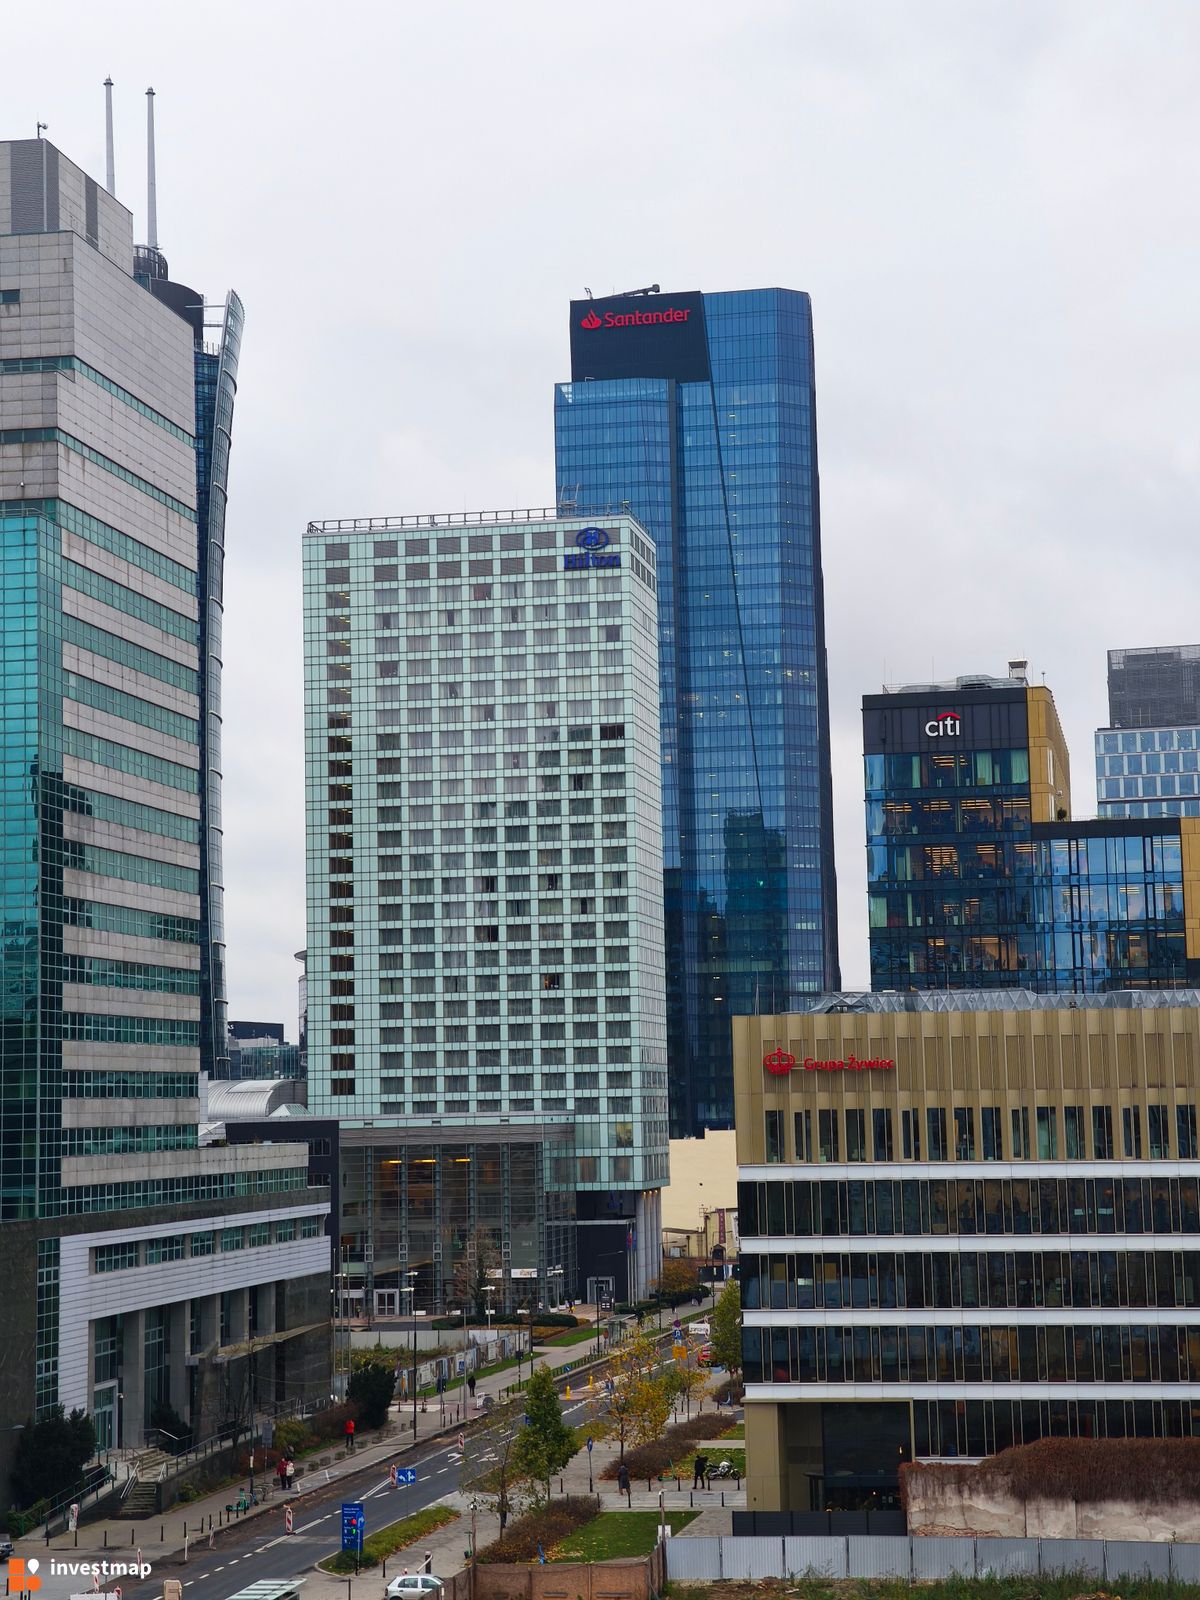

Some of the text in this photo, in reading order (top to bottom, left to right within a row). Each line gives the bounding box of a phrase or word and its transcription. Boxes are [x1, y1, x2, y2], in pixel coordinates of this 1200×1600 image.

[604, 308, 690, 328] Santander
[564, 551, 621, 570] Hilton
[925, 714, 960, 737] citi
[804, 1057, 844, 1072] Grupa
